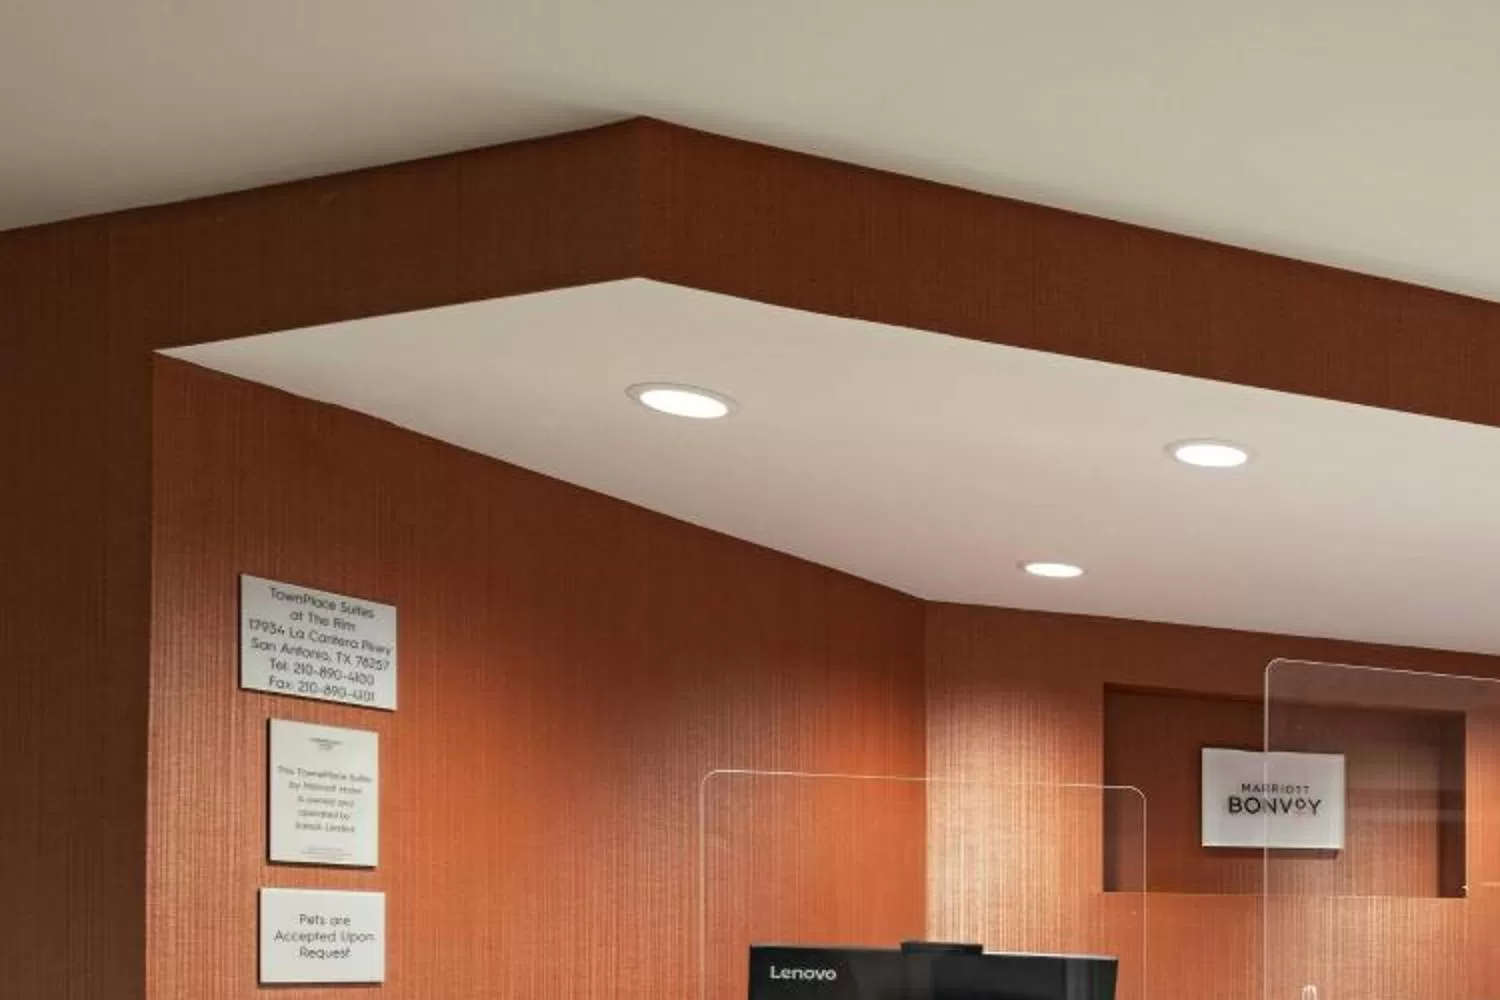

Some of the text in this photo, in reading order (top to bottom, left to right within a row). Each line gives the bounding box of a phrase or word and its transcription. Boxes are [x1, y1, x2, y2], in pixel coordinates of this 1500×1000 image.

[340, 601, 375, 619] Suites
[289, 610, 356, 632] at The Rim
[289, 626, 305, 639] La
[251, 637, 277, 651] San
[336, 651, 351, 665] TX
[1241, 783, 1310, 794] MARRIOTT
[1228, 796, 1322, 815] BONVOY
[299, 913, 351, 926] Pets are
[274, 930, 374, 943] Accepted Upon
[299, 946, 351, 960] Request
[770, 965, 837, 980] Lenovo
